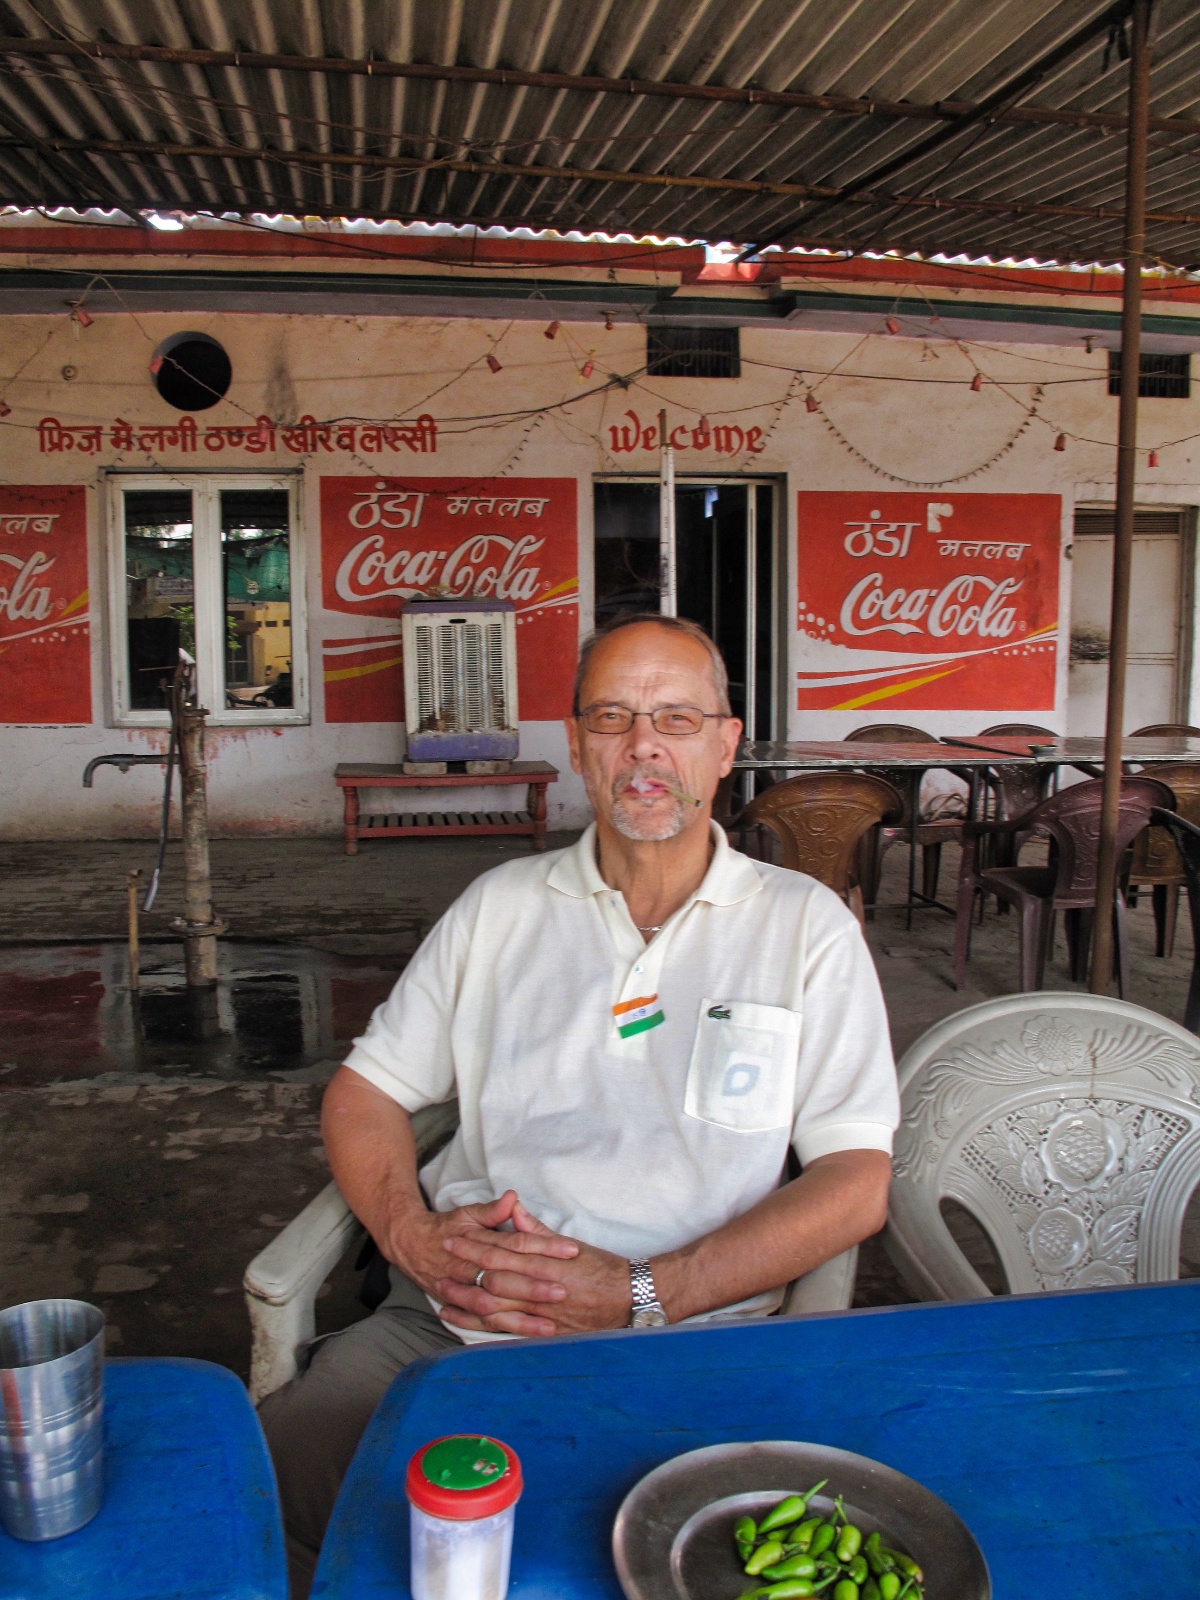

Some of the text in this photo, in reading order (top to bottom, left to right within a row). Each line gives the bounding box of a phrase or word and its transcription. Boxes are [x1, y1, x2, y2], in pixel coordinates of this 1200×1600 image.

[0, 513, 61, 535] लब
[348, 481, 550, 529] ठंडा मतलब
[844, 509, 1032, 561] ठंडा मतलब
[334, 534, 546, 602] Coca-Cola
[839, 572, 1026, 637] Coca-Cola
